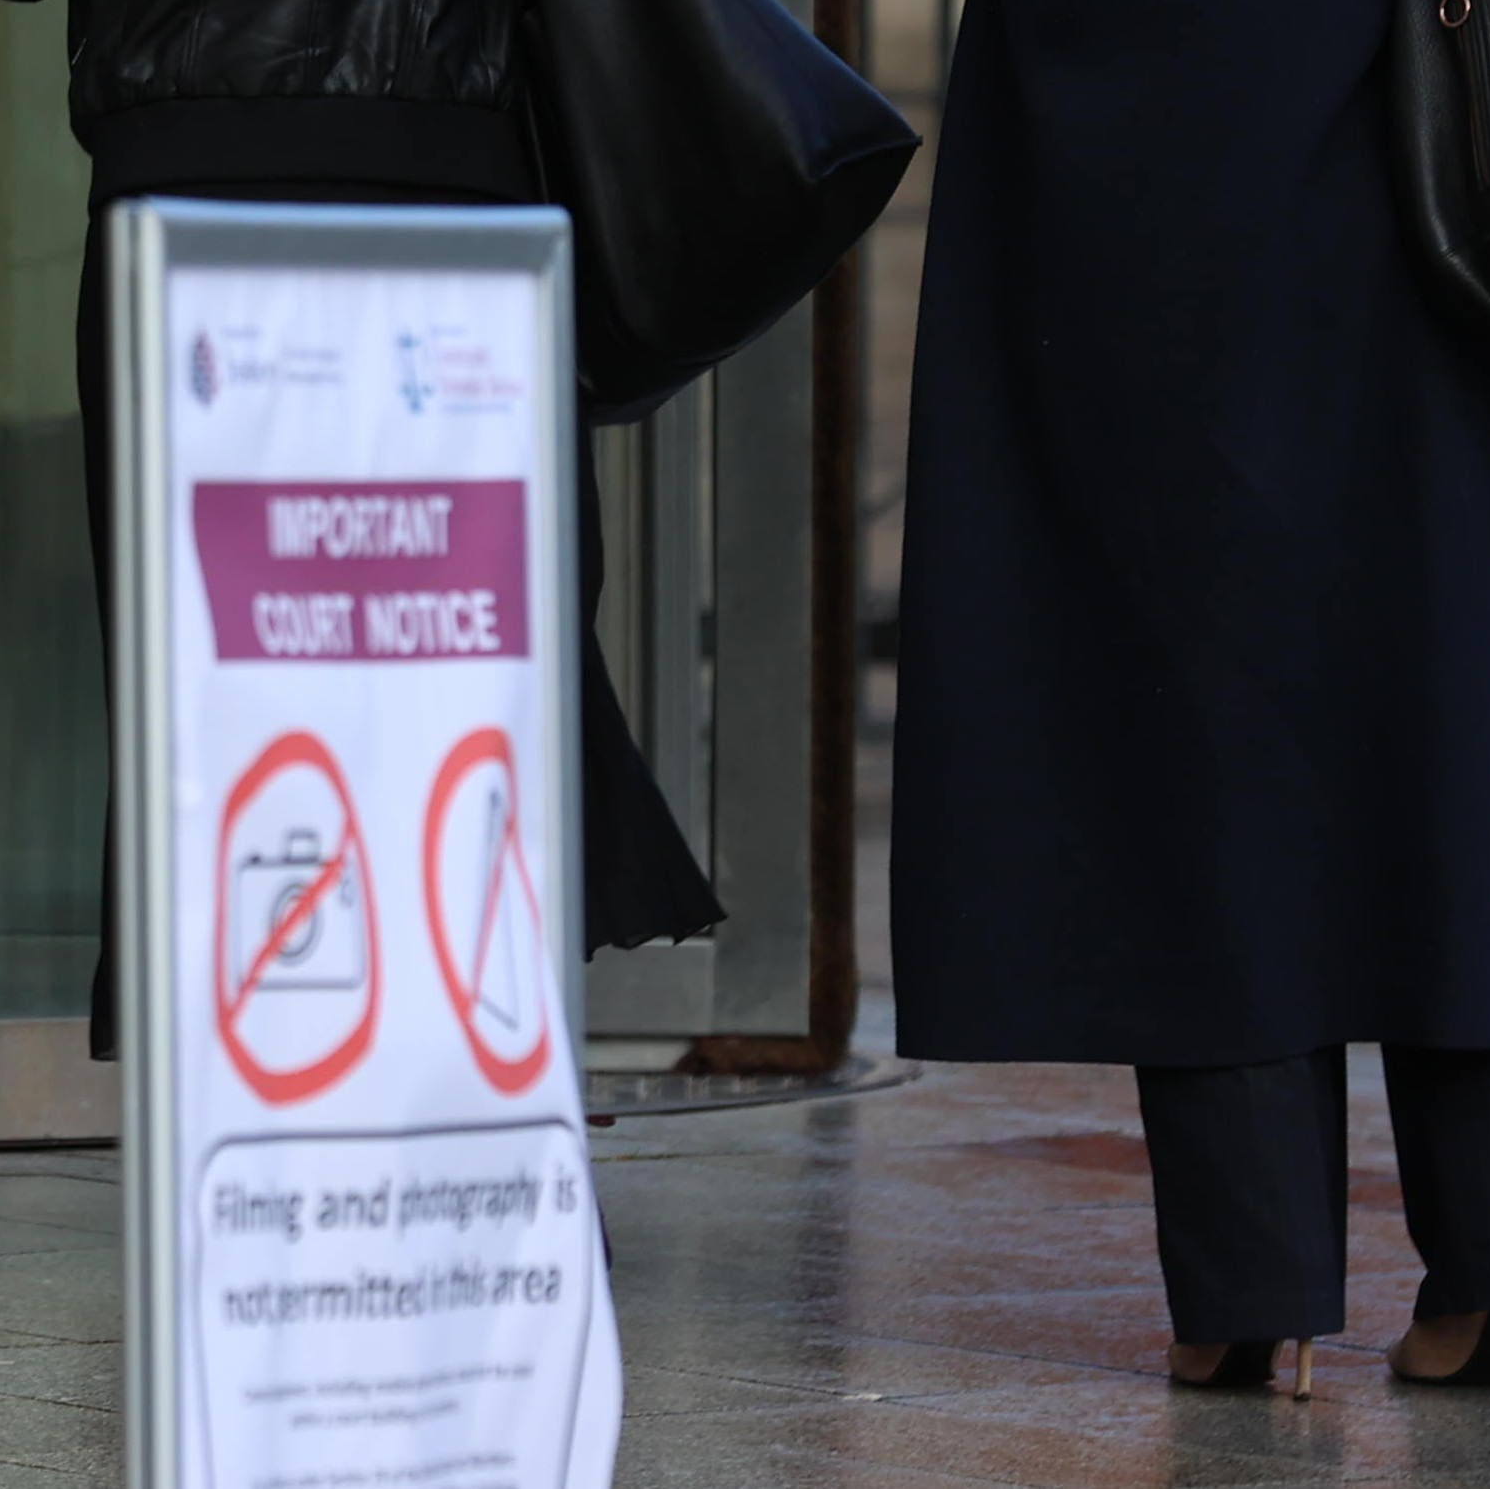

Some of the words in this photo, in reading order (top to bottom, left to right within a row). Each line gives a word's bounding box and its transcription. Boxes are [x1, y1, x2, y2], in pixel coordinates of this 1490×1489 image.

[266, 494, 453, 560] IMPORTANT
[252, 591, 355, 655] COURT
[364, 589, 502, 653] NOTICE
[316, 1177, 393, 1228] and
[556, 1164, 578, 1213] is
[224, 1282, 271, 1328] not
[492, 1262, 561, 1306] area
